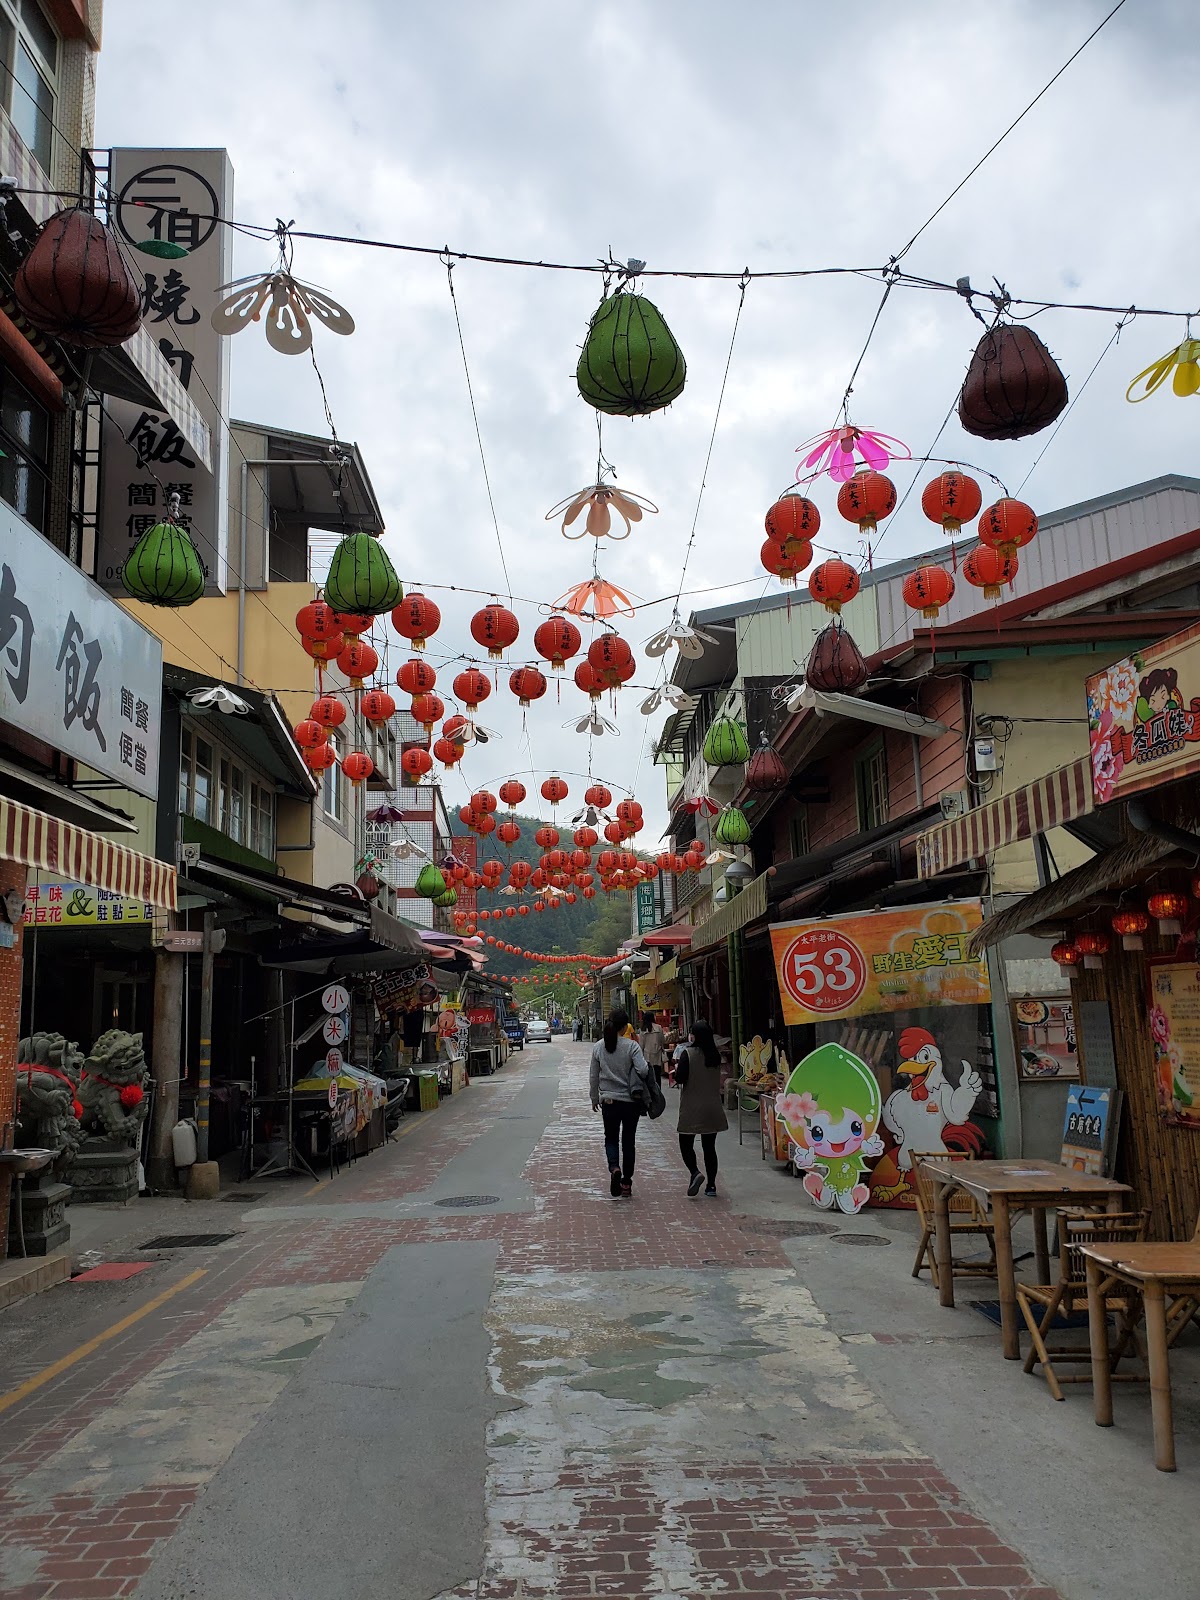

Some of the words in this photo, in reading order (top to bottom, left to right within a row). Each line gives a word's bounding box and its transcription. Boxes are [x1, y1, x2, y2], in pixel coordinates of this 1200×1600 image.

[66, 888, 93, 916] &
[97, 904, 152, 921] 駐點二店
[801, 933, 836, 945] 太平老街
[794, 948, 856, 995] 53
